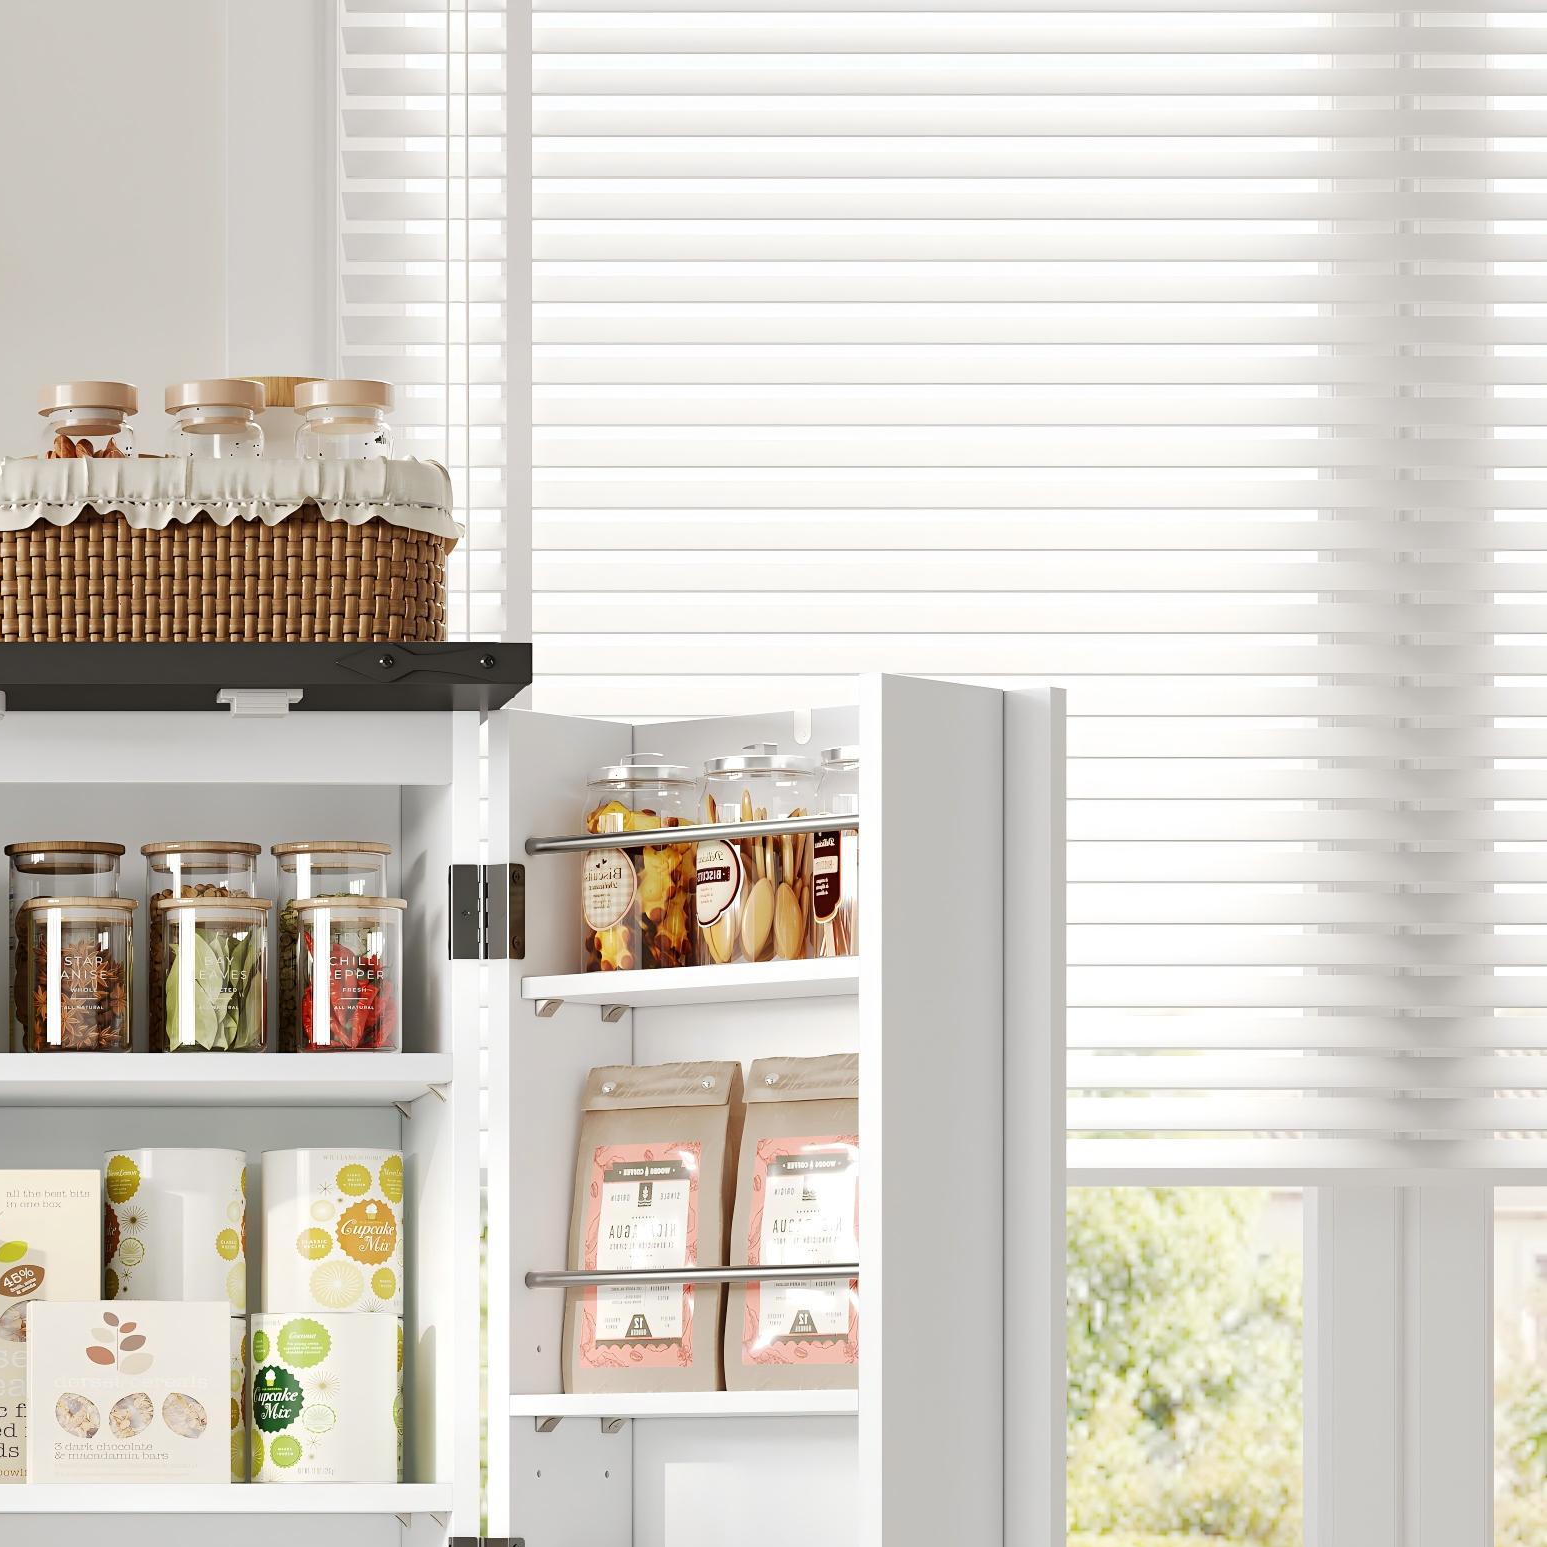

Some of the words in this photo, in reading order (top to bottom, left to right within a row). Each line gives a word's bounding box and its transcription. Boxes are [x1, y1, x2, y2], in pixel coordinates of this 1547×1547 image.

[64, 956, 103, 966] STAR
[205, 956, 234, 966] BAY
[329, 956, 380, 966] CHILLI
[60, 970, 108, 980] ANISE
[195, 970, 248, 980] EAVES
[330, 969, 384, 980] EPPER
[6, 1189, 20, 1198] all
[23, 1189, 41, 1198] the
[44, 1189, 68, 1198] best
[69, 1189, 90, 1198] bits
[340, 1219, 394, 1239] Cupcake
[359, 1235, 390, 1252] Mix
[253, 1386, 299, 1405] Cupcake
[261, 1402, 292, 1420] Mix
[54, 1442, 62, 1451] 3
[64, 1442, 93, 1451] dark
[96, 1442, 153, 1451] chocolate
[54, 1452, 65, 1460] &
[68, 1452, 139, 1460] macadamia
[142, 1452, 169, 1460] bars
